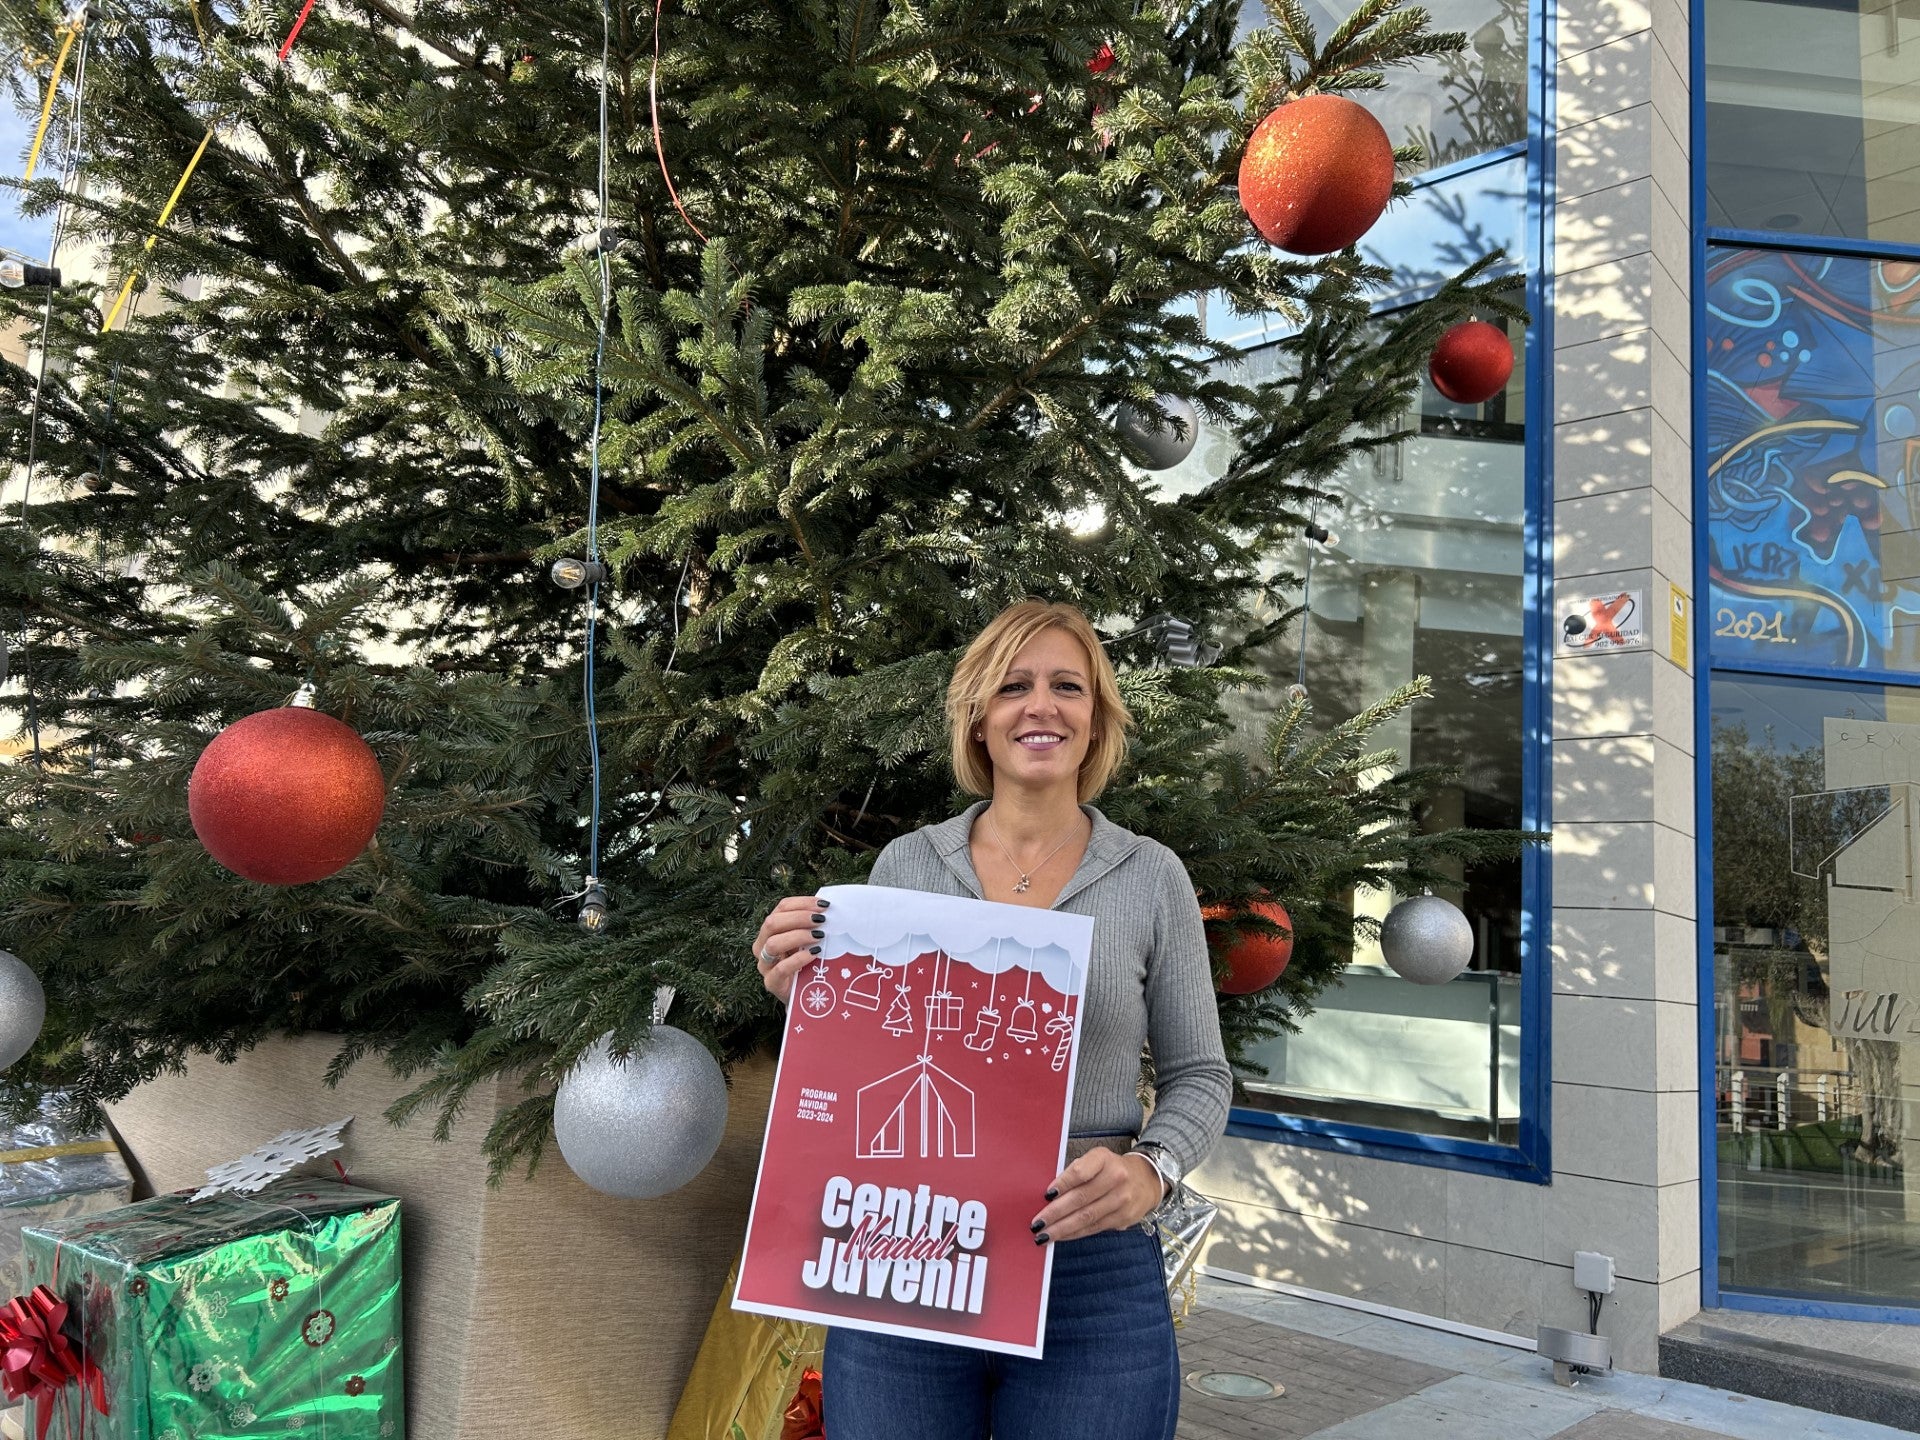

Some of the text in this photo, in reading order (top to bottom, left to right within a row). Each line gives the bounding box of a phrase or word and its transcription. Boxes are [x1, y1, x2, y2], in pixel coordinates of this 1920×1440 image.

[1714, 607, 1797, 644] 2021.
[1596, 628, 1640, 640] SEGURIDAD
[801, 1088, 838, 1102] PROGRAMA
[799, 1098, 828, 1111] NAVIDAD
[796, 1108, 834, 1123] 2023-2024
[842, 1212, 960, 1264] Nadal
[801, 1236, 988, 1315] Juvenil
